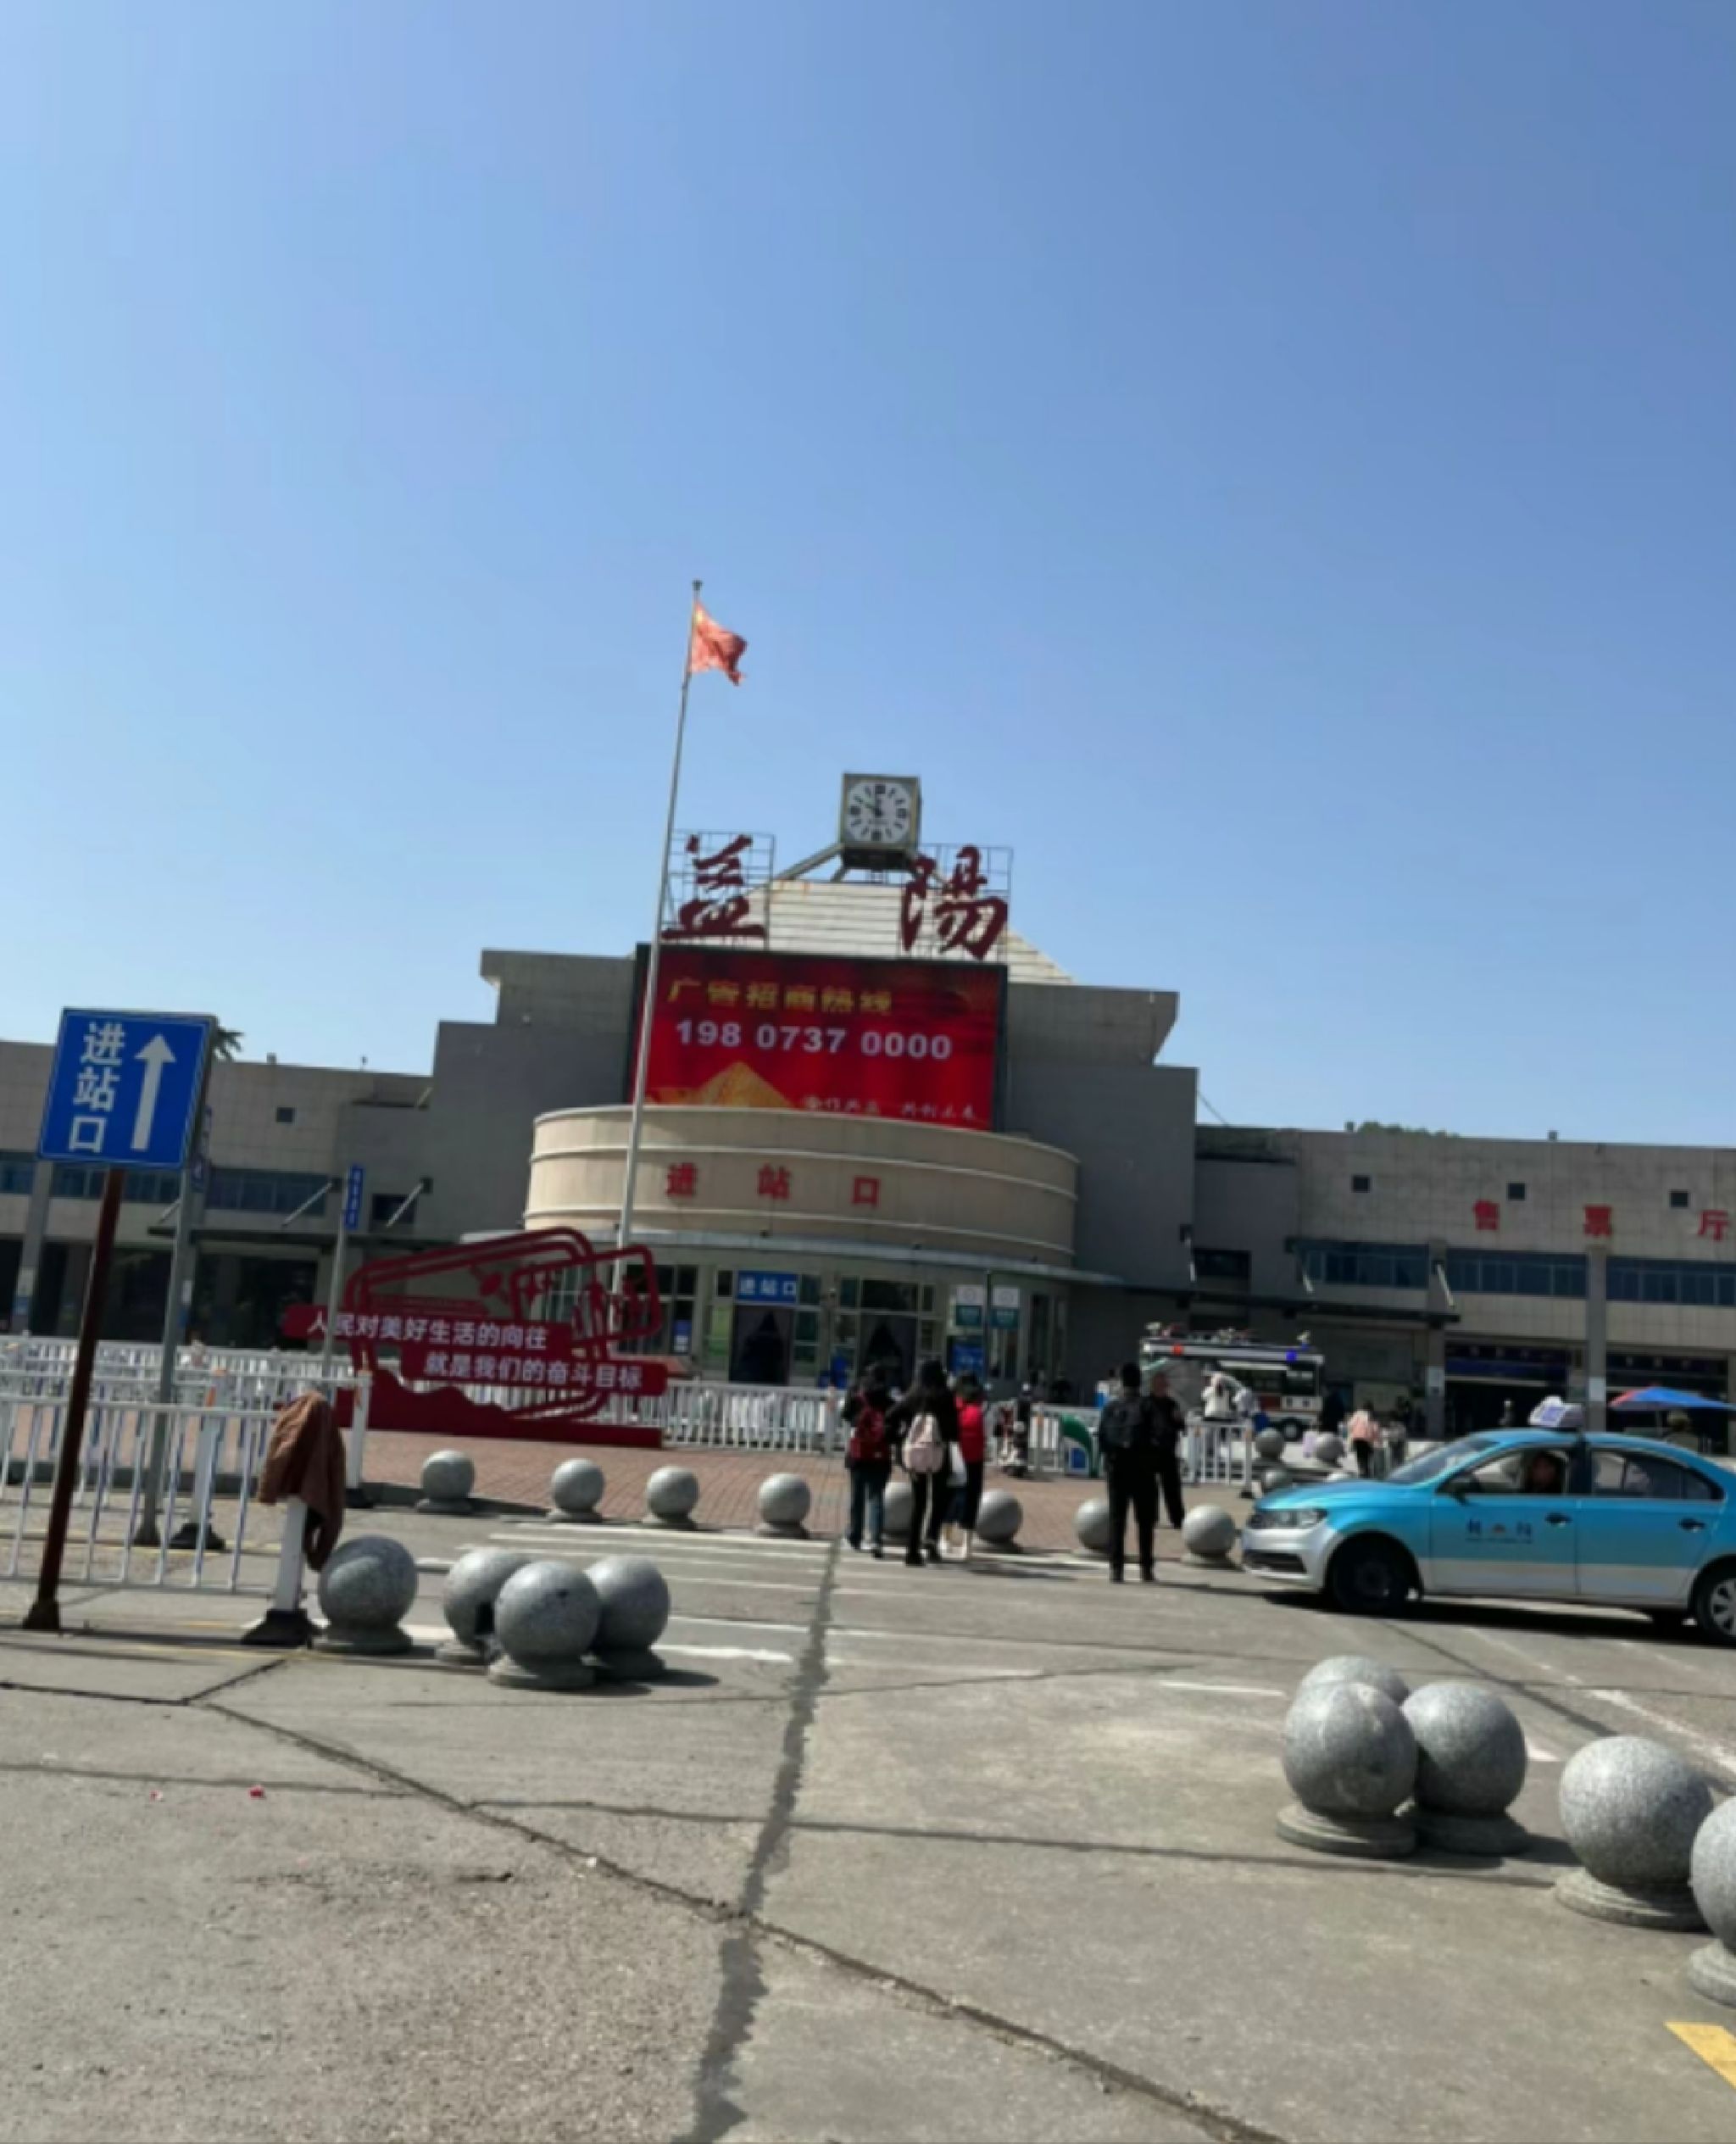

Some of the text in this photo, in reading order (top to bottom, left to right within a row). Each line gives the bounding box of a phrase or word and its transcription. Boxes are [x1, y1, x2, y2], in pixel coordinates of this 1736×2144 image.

[676, 1019, 953, 1060] 198 0737 0000
[68, 1022, 125, 1153] 进站口
[666, 1162, 881, 1206] 进站口
[1473, 1200, 1730, 1241] 售票厅
[426, 1351, 642, 1388] 就是我们的奋斗目标
